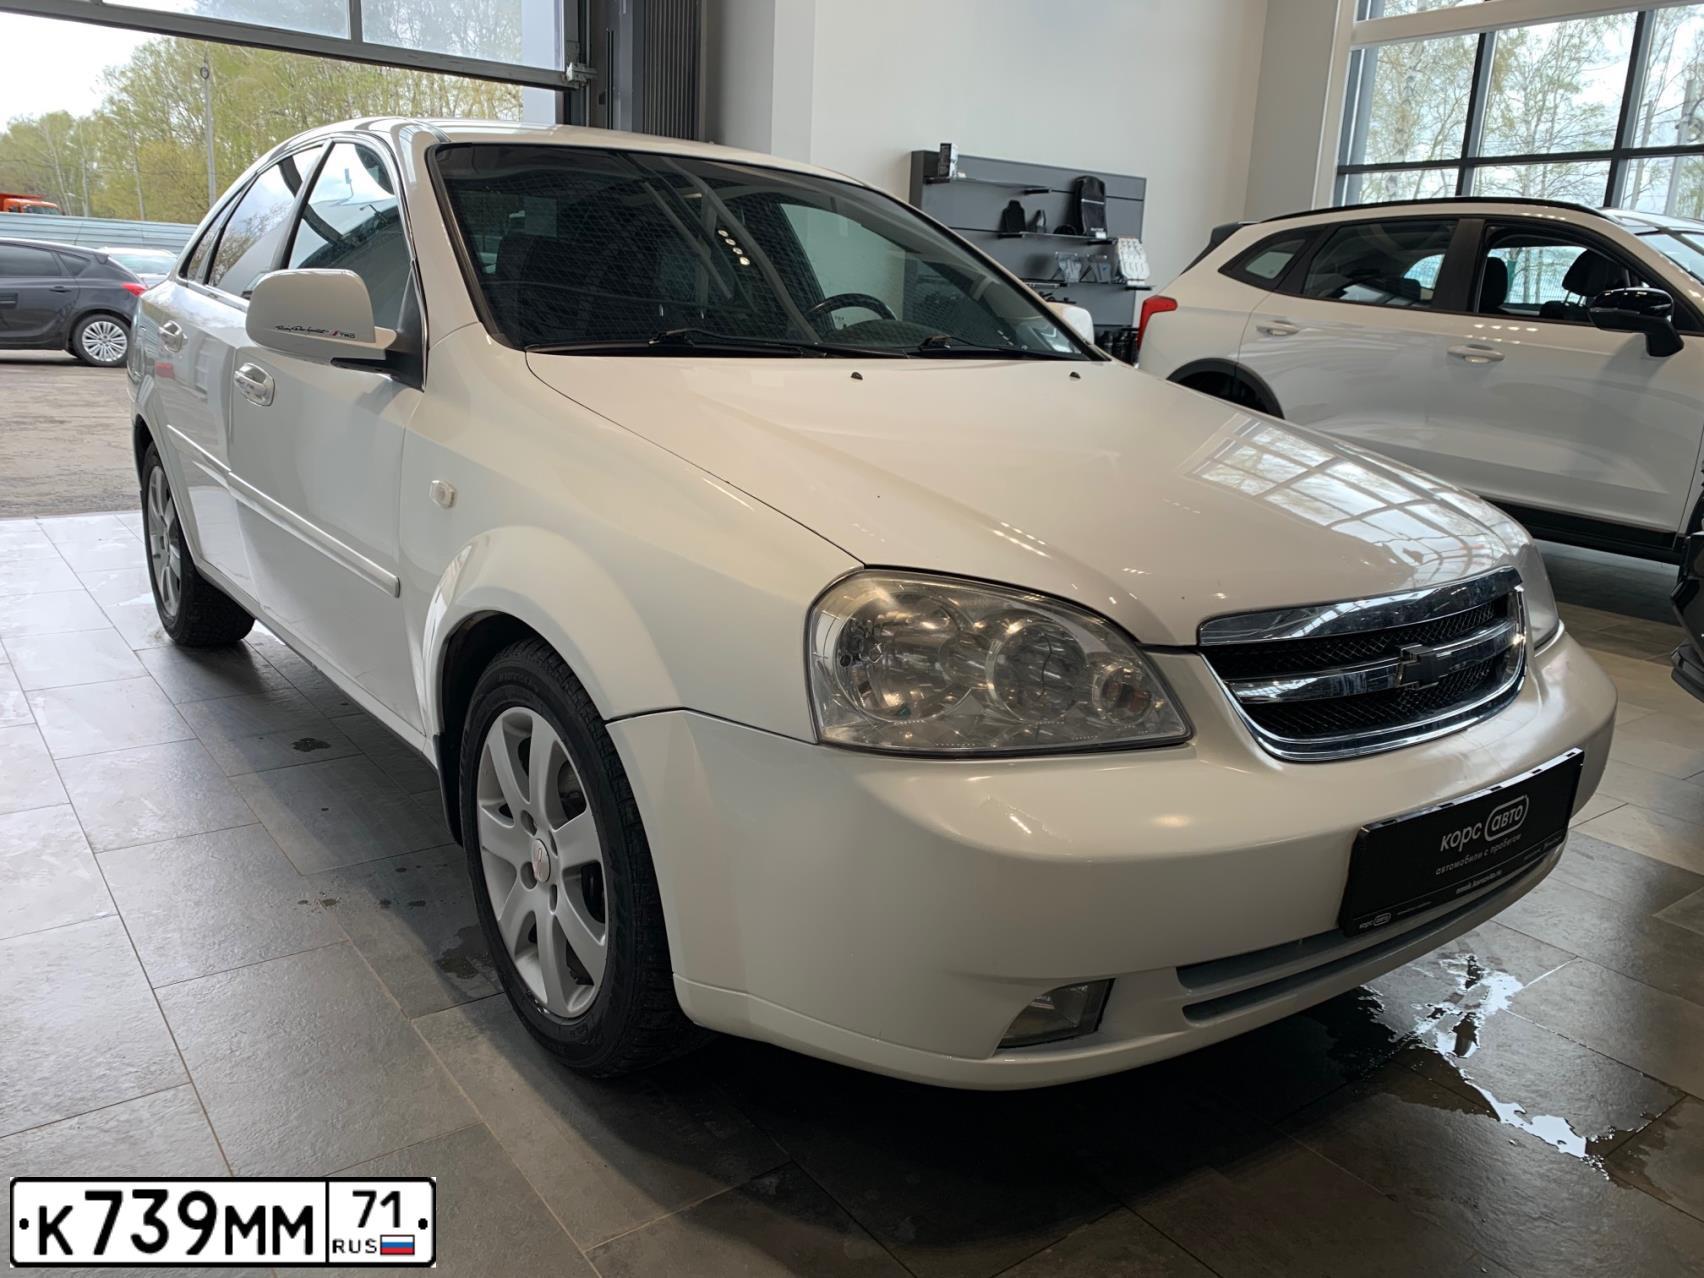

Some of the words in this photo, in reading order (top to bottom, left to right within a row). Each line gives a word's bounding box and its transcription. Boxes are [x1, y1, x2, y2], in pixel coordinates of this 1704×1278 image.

[1440, 821, 1483, 852] корс
[1491, 804, 1524, 831] авто
[1435, 850, 1483, 876] автомобили
